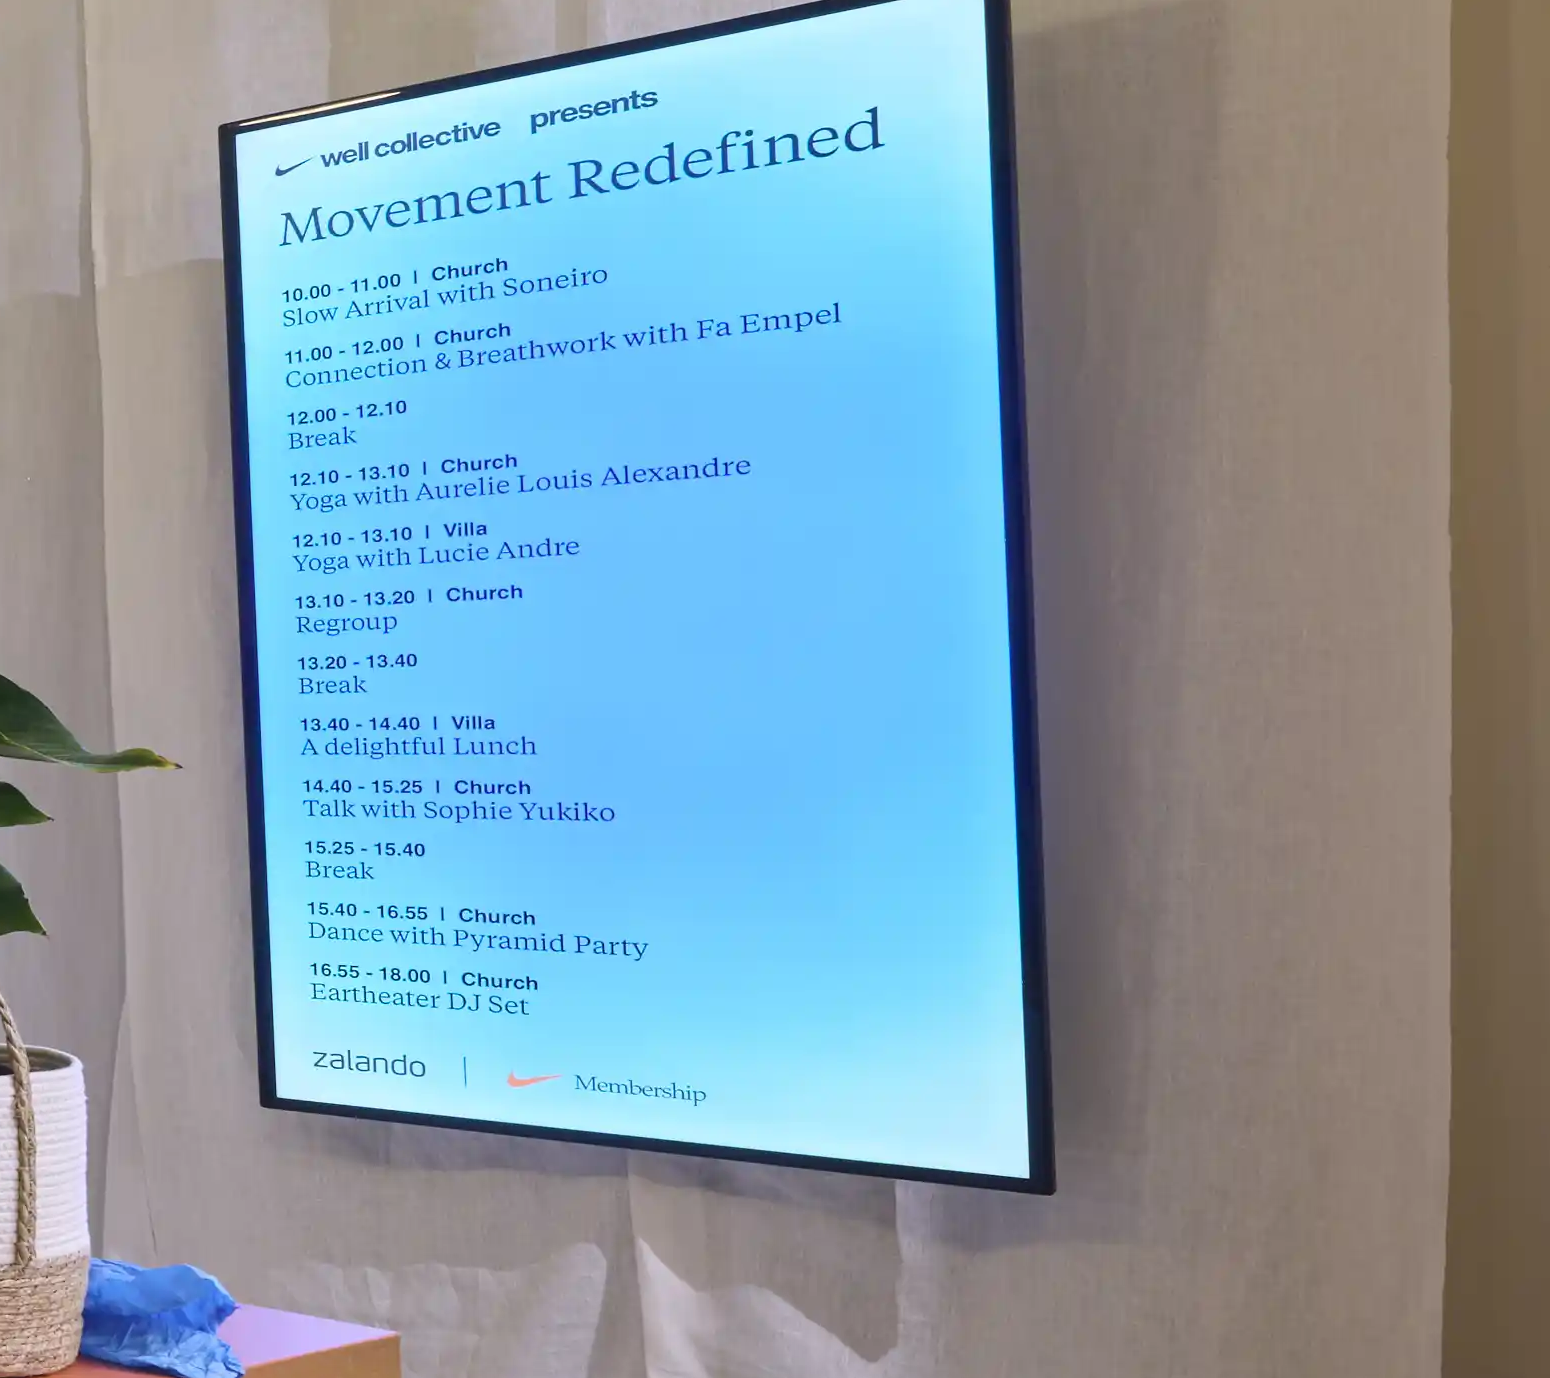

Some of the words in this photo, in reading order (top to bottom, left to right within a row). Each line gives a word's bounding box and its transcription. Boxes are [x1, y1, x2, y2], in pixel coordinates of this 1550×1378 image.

[319, 140, 369, 167] well
[374, 121, 501, 157] collective
[530, 89, 658, 134] presents
[278, 170, 552, 246] Movement
[566, 106, 885, 199] Redefined
[281, 283, 331, 303] 10.00
[350, 273, 400, 293] 11.00
[431, 257, 507, 281] Church
[282, 306, 338, 327] Slow
[344, 288, 429, 319] Arrival
[436, 281, 495, 305] with
[502, 267, 607, 296] Soneiro
[284, 345, 332, 364] 11.00
[351, 336, 403, 355] 12.00
[434, 322, 510, 345] Church
[285, 357, 427, 387] Connection
[434, 352, 451, 369] &
[457, 330, 616, 368] Breathwork
[621, 322, 688, 346] with
[696, 318, 732, 339] Fa
[739, 301, 841, 334] Empel
[286, 407, 336, 425] 12.00
[355, 399, 406, 418] 12.10
[287, 425, 357, 449] Break
[289, 469, 338, 486] 12.10
[358, 463, 409, 480] 13.10
[440, 453, 517, 473] Church
[289, 493, 347, 513] Yoga
[352, 484, 409, 505] with
[415, 475, 509, 501] Aurelie
[516, 469, 592, 493] Louis
[601, 456, 750, 486] Alexandre
[292, 531, 341, 548] 12.10
[360, 526, 412, 543] 13.10
[443, 521, 486, 537] Villa
[292, 554, 349, 574] Yoga
[355, 547, 411, 568] with
[417, 542, 489, 564] Lucie
[495, 537, 579, 559] Andre
[294, 593, 344, 609] 13.10
[363, 589, 414, 606] 13.20
[445, 584, 522, 602] Church
[295, 615, 397, 636] Regroup
[296, 655, 346, 670] 13.20
[365, 653, 417, 668] 13.40
[298, 674, 367, 694] Break
[300, 717, 349, 731] 13.40
[368, 716, 420, 730] 14.40
[451, 715, 495, 730] Villa
[300, 738, 319, 755] A
[324, 736, 445, 759] delightful
[453, 735, 537, 755] Lunch
[302, 779, 351, 793] 14.40
[371, 779, 422, 794] 15.25
[453, 779, 530, 794] Church
[302, 798, 355, 817] Talk
[360, 799, 416, 818] with
[423, 800, 512, 823] Sophie
[518, 801, 614, 821] Yukiko
[304, 840, 354, 855] 15.25
[373, 841, 425, 857] 15.40
[304, 860, 374, 879] Break
[307, 901, 356, 916] 15.40
[376, 904, 427, 920] 16.55
[458, 907, 535, 925] Church
[307, 921, 383, 942] Dance
[388, 926, 446, 945] with
[452, 929, 566, 952] Pyramid
[573, 935, 648, 961] Party
[309, 962, 359, 978] 16.55
[378, 966, 430, 983] 18.00
[461, 971, 538, 990] Church
[309, 982, 440, 1008] Eartheater
[446, 991, 481, 1011] DJ
[488, 994, 529, 1015] Set
[312, 1049, 425, 1077] zalando
[574, 1074, 706, 1106] Membership
